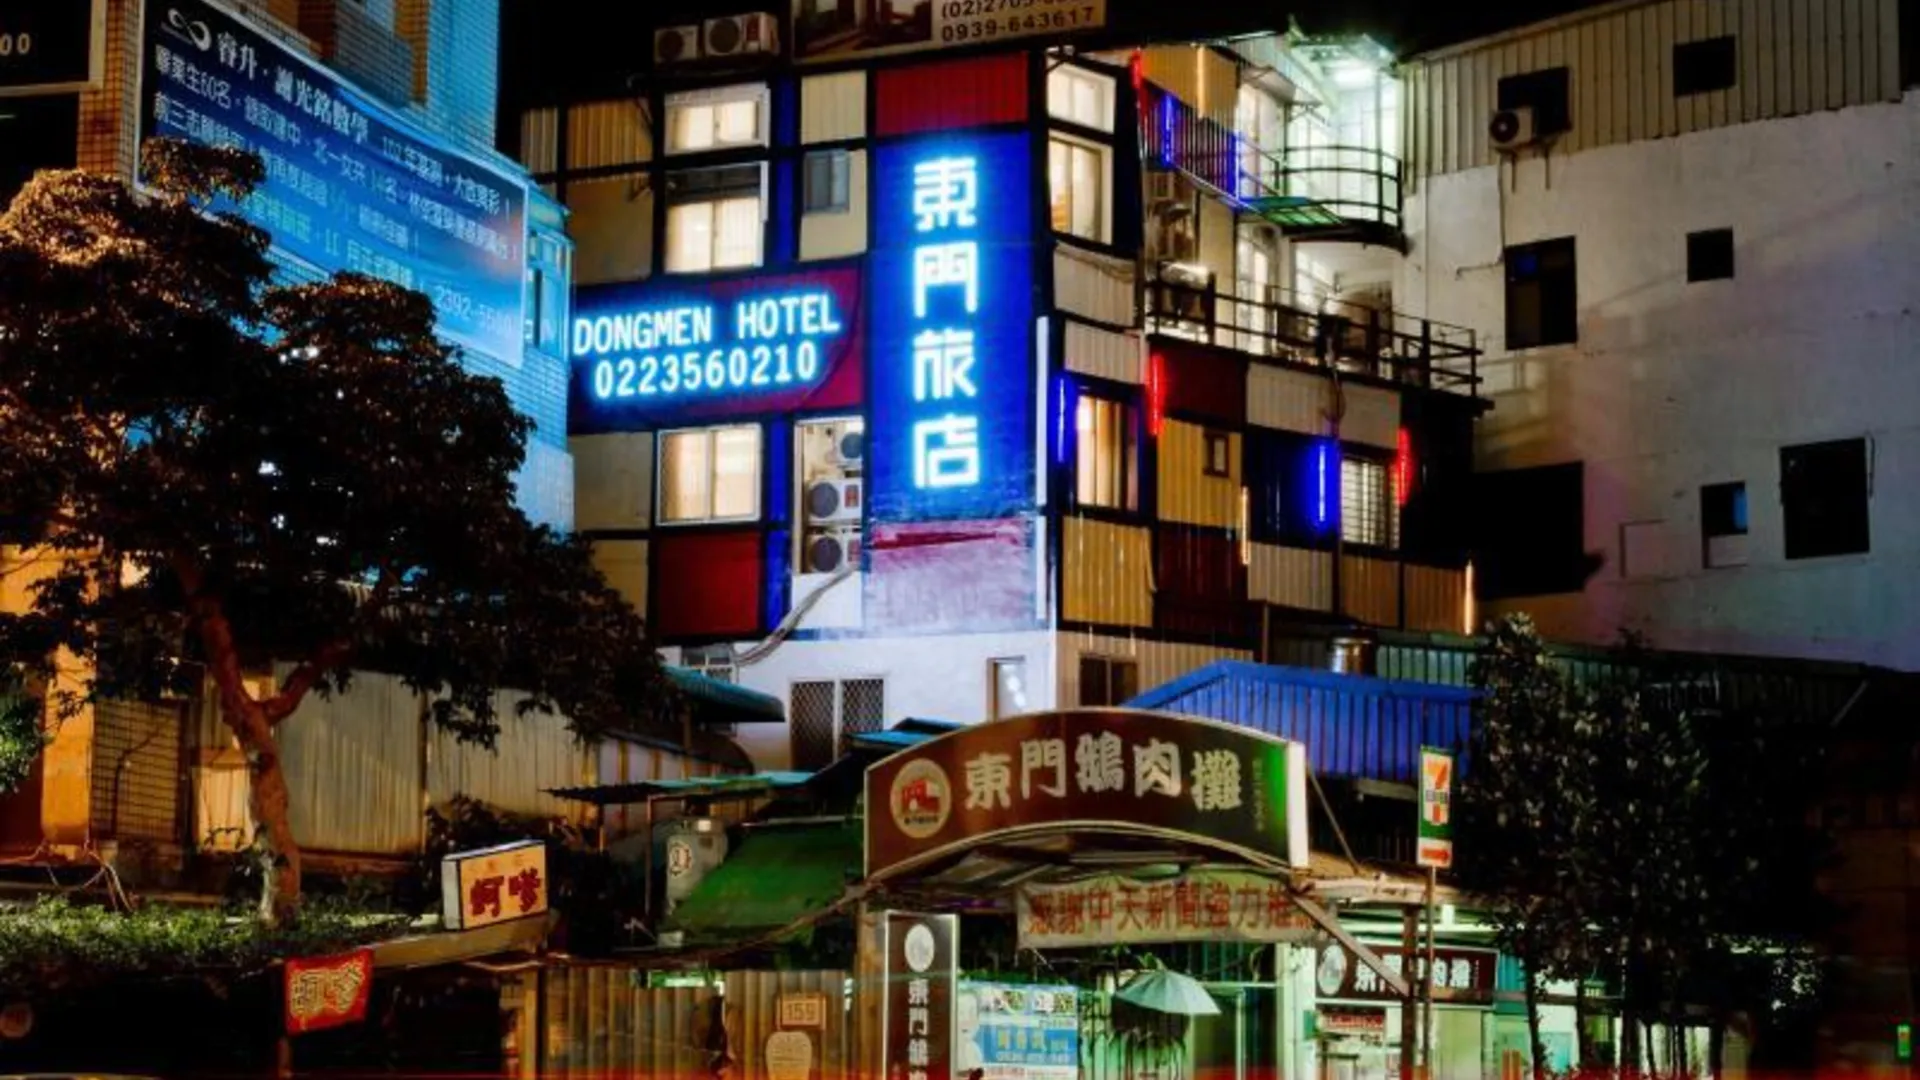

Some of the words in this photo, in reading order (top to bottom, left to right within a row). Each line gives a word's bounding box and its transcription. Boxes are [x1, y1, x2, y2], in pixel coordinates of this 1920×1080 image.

[941, 6, 1096, 42] 0939-643617
[573, 306, 712, 356] DONGMEN
[736, 291, 841, 340] HOTEL
[911, 155, 980, 489] 東門旅店
[594, 341, 817, 398] 0223560210
[964, 731, 1243, 812] 東門鵝肉攤
